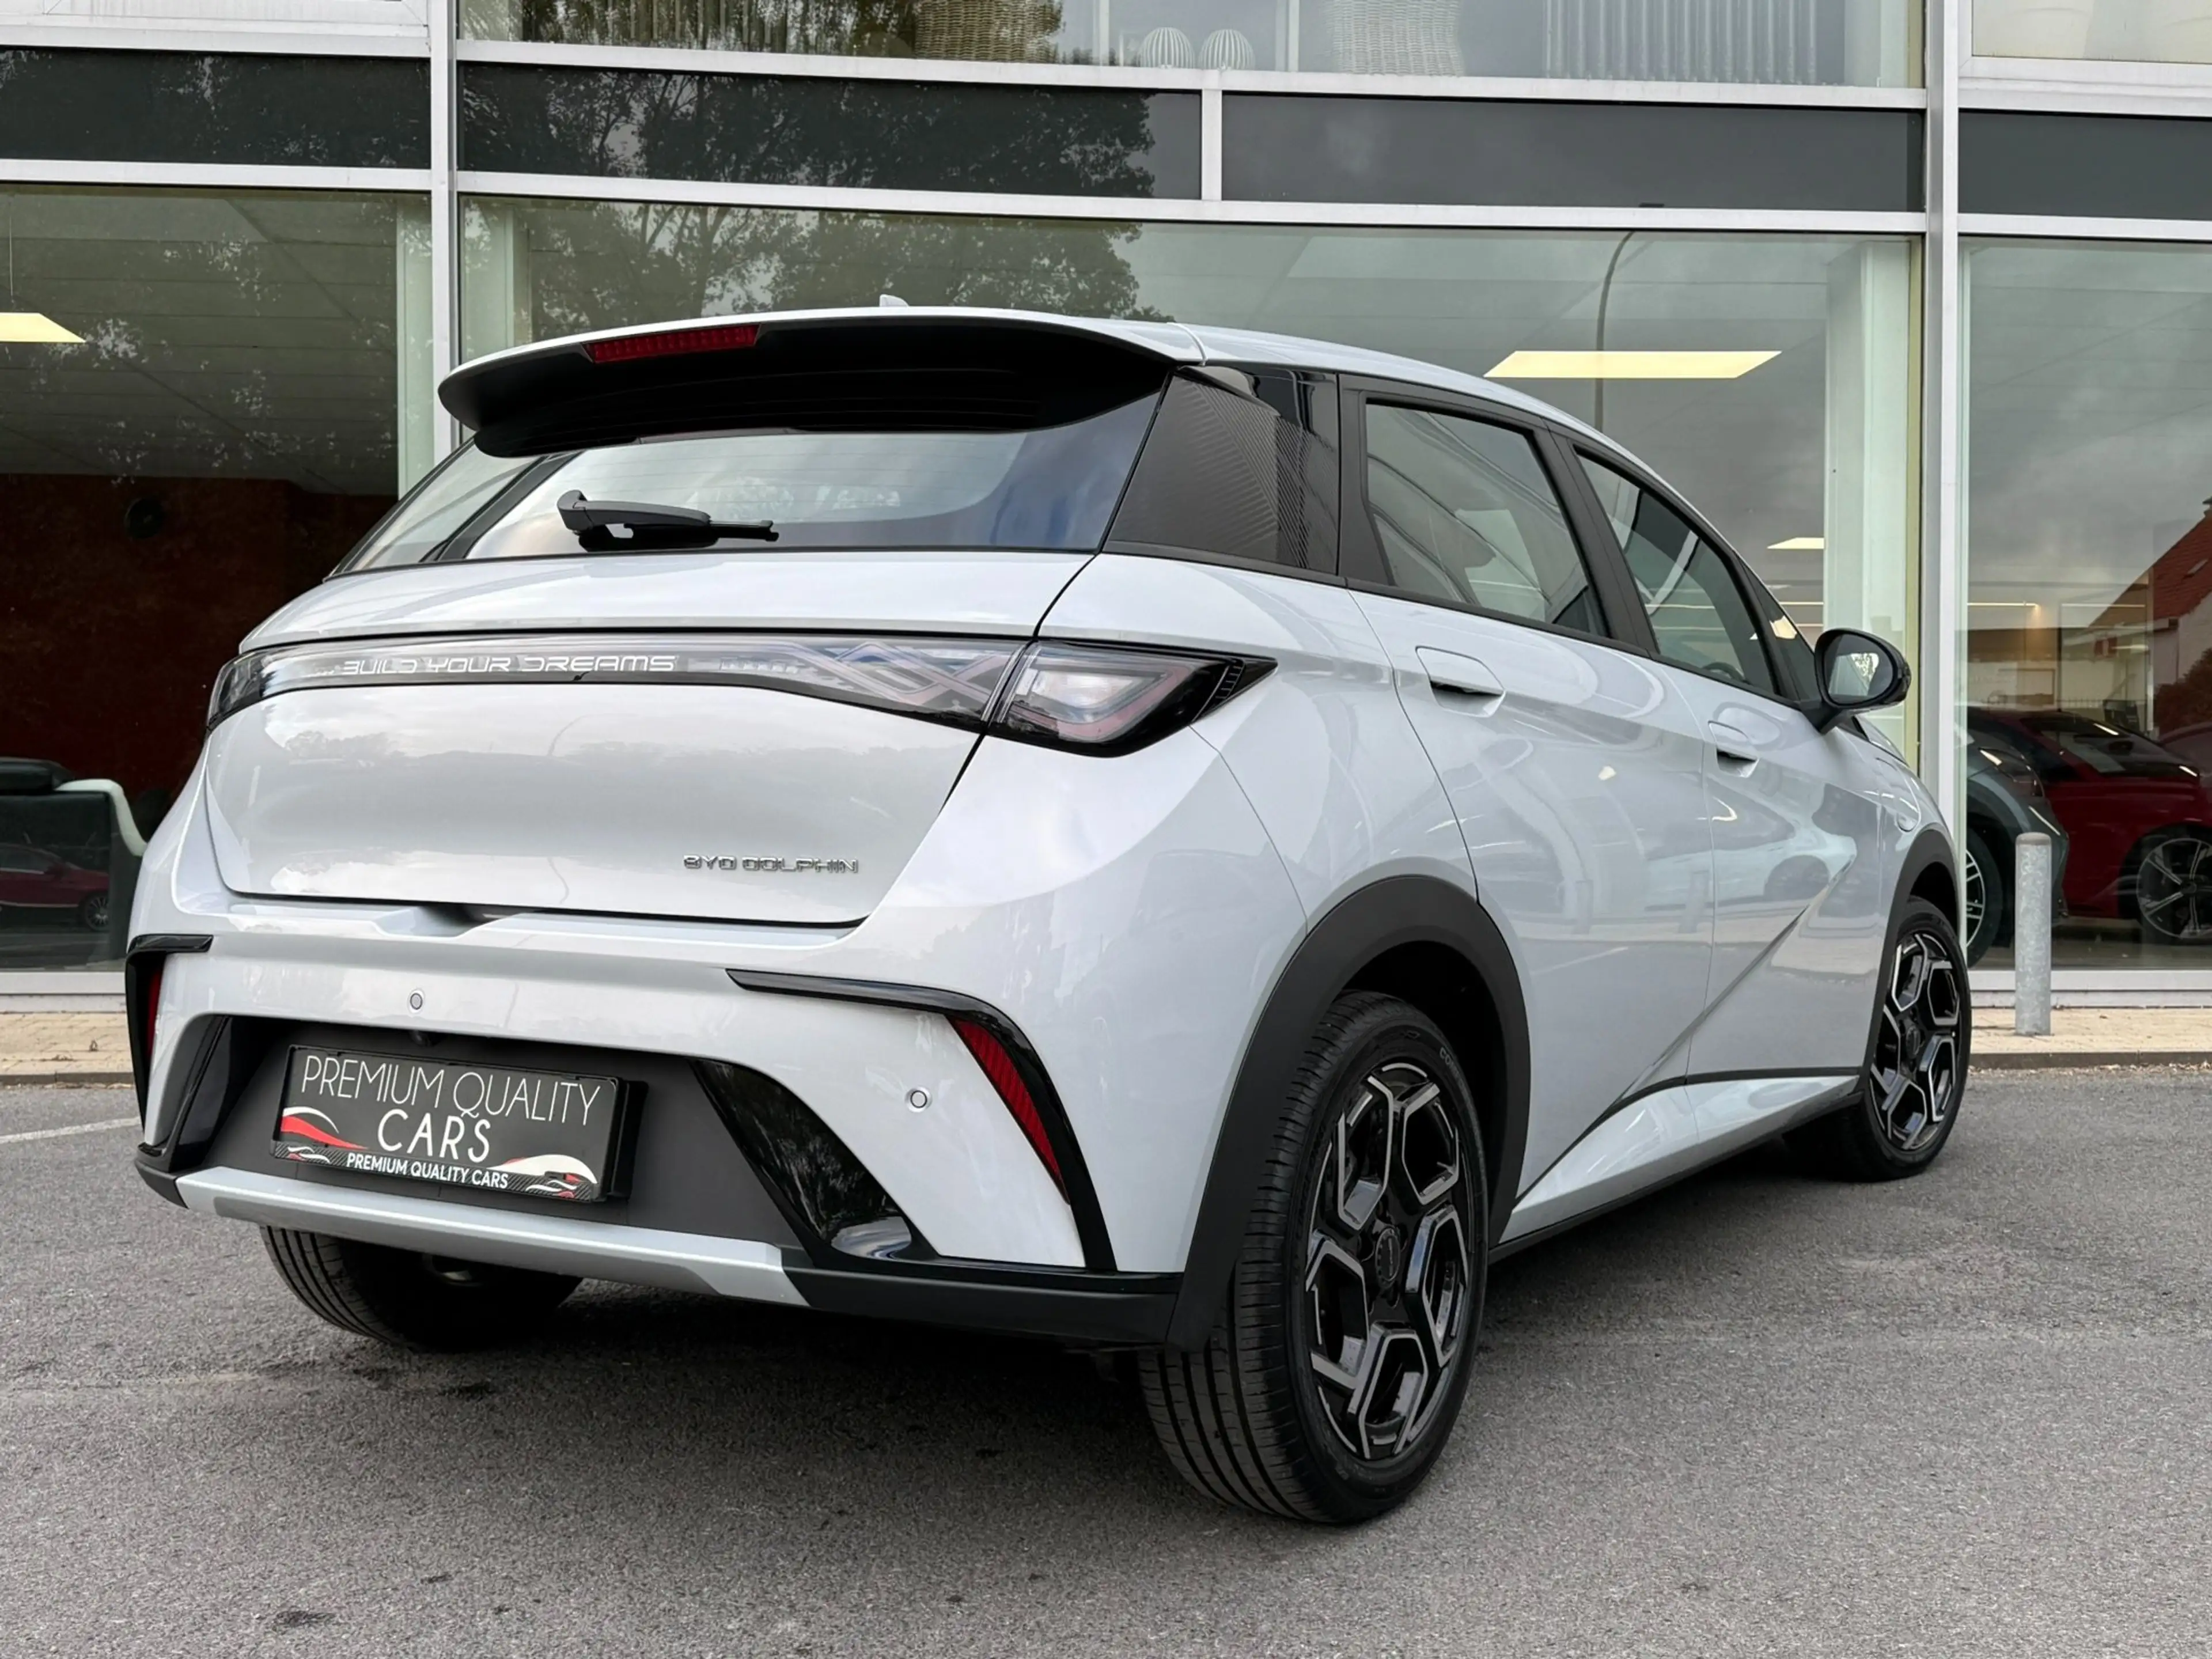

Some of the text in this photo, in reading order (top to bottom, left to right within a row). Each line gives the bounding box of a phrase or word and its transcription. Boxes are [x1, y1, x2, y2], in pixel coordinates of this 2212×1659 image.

[341, 656, 676, 675] BUILD YOUR DREAMS
[683, 855, 858, 873] BYD DOLPHIN
[301, 1055, 601, 1126] PREMIUM QUALITY
[377, 1108, 491, 1163] CARS
[346, 1153, 509, 1190] PREMIUM QUALITY CARS
